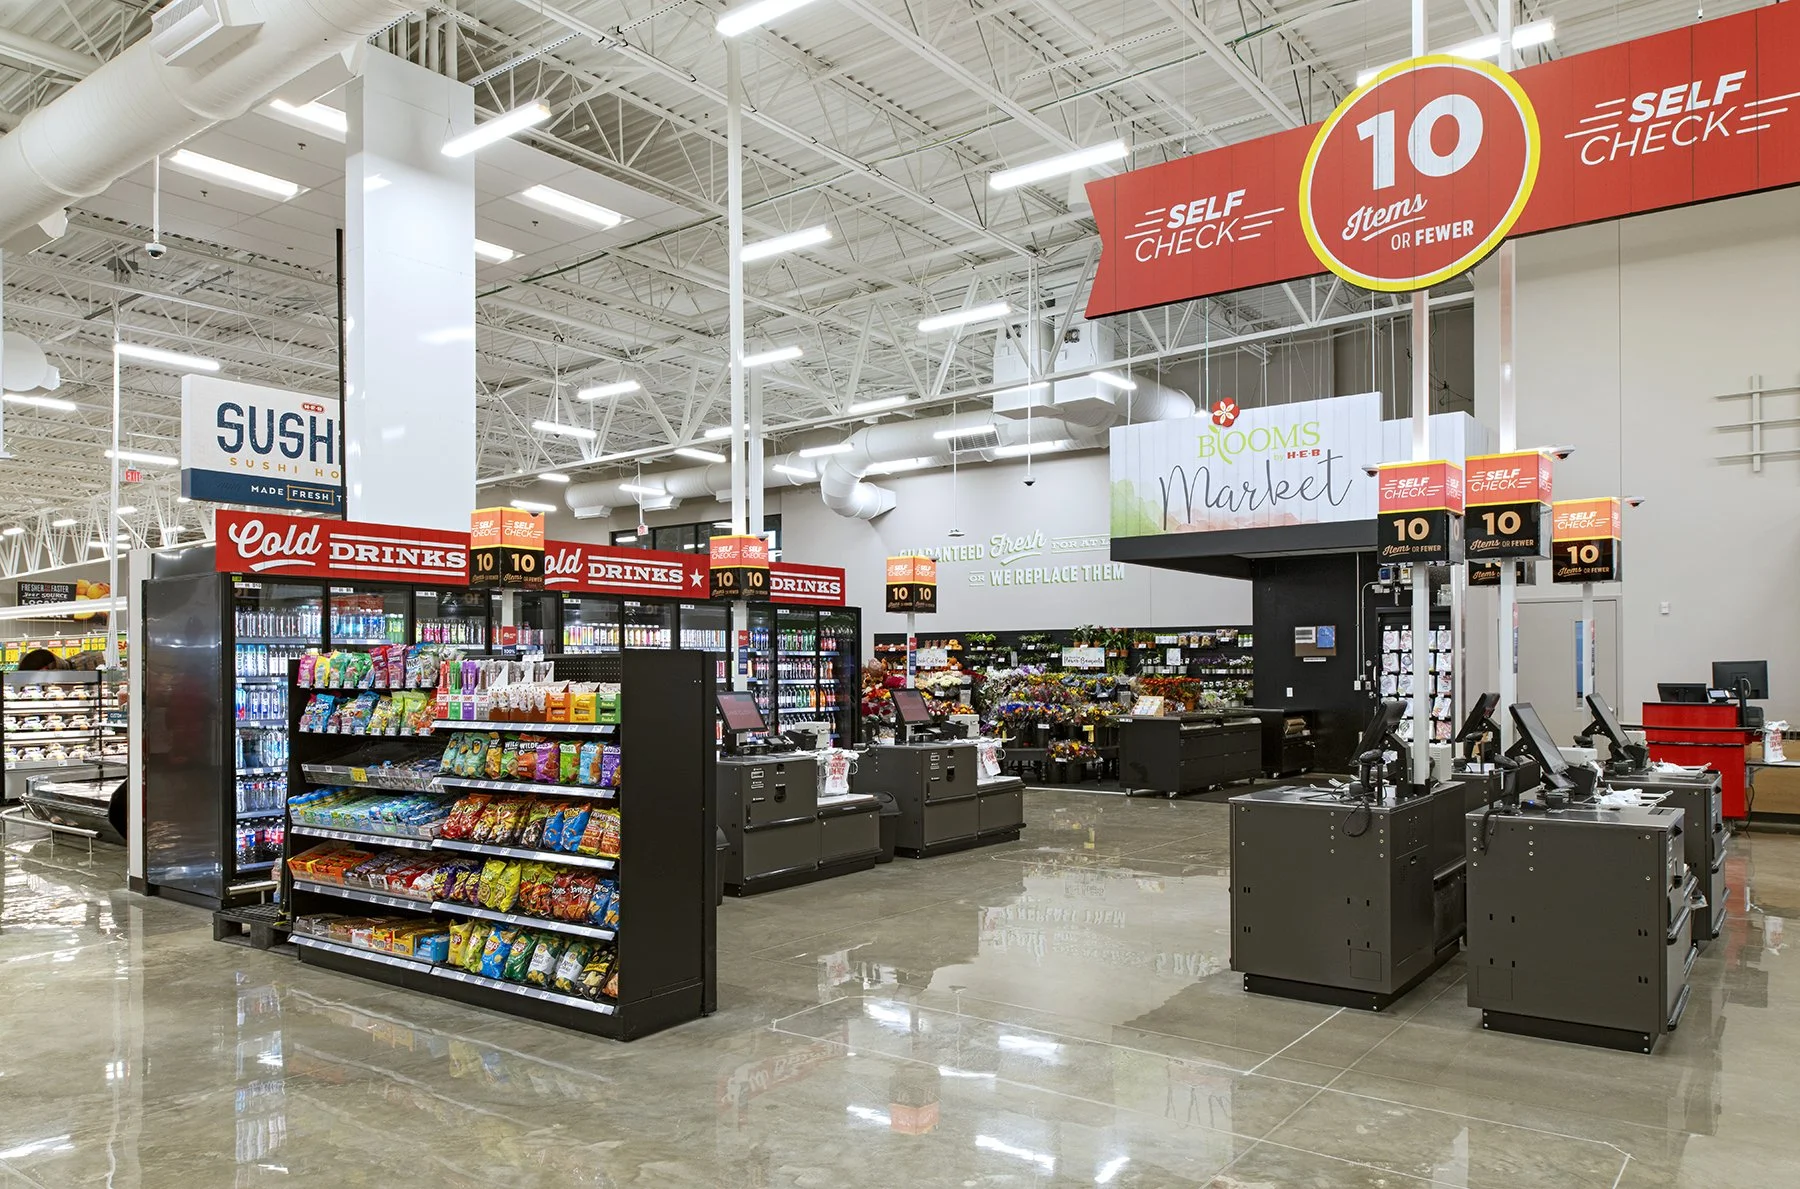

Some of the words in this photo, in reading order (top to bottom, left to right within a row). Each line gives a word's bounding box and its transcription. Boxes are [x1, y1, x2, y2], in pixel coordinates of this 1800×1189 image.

[1627, 70, 1747, 123] SELF
[1356, 94, 1484, 191] 10
[1580, 106, 1738, 166] CHECK
[1166, 188, 1247, 229] SELF
[1341, 193, 1429, 241] Items
[1135, 217, 1240, 262] CHECK
[1391, 233, 1411, 251] OR
[1415, 219, 1474, 247] FEWER
[1273, 453, 1284, 462] by
[126, 470, 140, 482] EXIT
[229, 457, 298, 475] SUSHI
[315, 468, 340, 479] HO
[1485, 468, 1521, 481] SELF
[1159, 448, 1353, 531] Market
[1397, 476, 1430, 489] SELF
[1471, 478, 1519, 492] CHECK
[251, 485, 284, 496] MADE
[292, 489, 329, 501] FRESH
[1384, 487, 1428, 500] CHECK
[1481, 511, 1521, 536] 10
[1569, 511, 1597, 521] SELF
[479, 520, 494, 529] SELF
[504, 527, 533, 538] CHECK
[514, 521, 535, 529] SELF
[1393, 517, 1430, 541] 10
[1557, 519, 1597, 530] CHECK
[228, 519, 322, 559] Cold
[329, 542, 467, 568] DRINKS
[989, 529, 1047, 558] Fresh
[1051, 540, 1077, 550] FOR
[1081, 539, 1098, 548] AT
[1382, 544, 1411, 557] Items
[1420, 544, 1442, 552] FEWER
[1469, 539, 1501, 551] Items
[1511, 539, 1534, 547] FEWER
[476, 553, 494, 572] 10
[1566, 544, 1599, 565] 10
[511, 553, 536, 573] 10
[544, 548, 583, 575] old
[588, 563, 684, 584] DRINKS
[716, 571, 734, 587] 10
[747, 571, 764, 588] 10
[969, 574, 985, 583] OR
[989, 569, 1012, 587] WE
[1014, 565, 1078, 585] REPLACE
[1077, 562, 1125, 582] THEM
[1472, 570, 1496, 580] Items
[1557, 567, 1582, 577] Items
[1591, 566, 1610, 574] FEWER
[21, 583, 45, 593] FRESHER
[51, 585, 70, 593] FASTER
[770, 577, 841, 594] DRINKS
[892, 586, 909, 600] 10
[918, 587, 932, 601] 10
